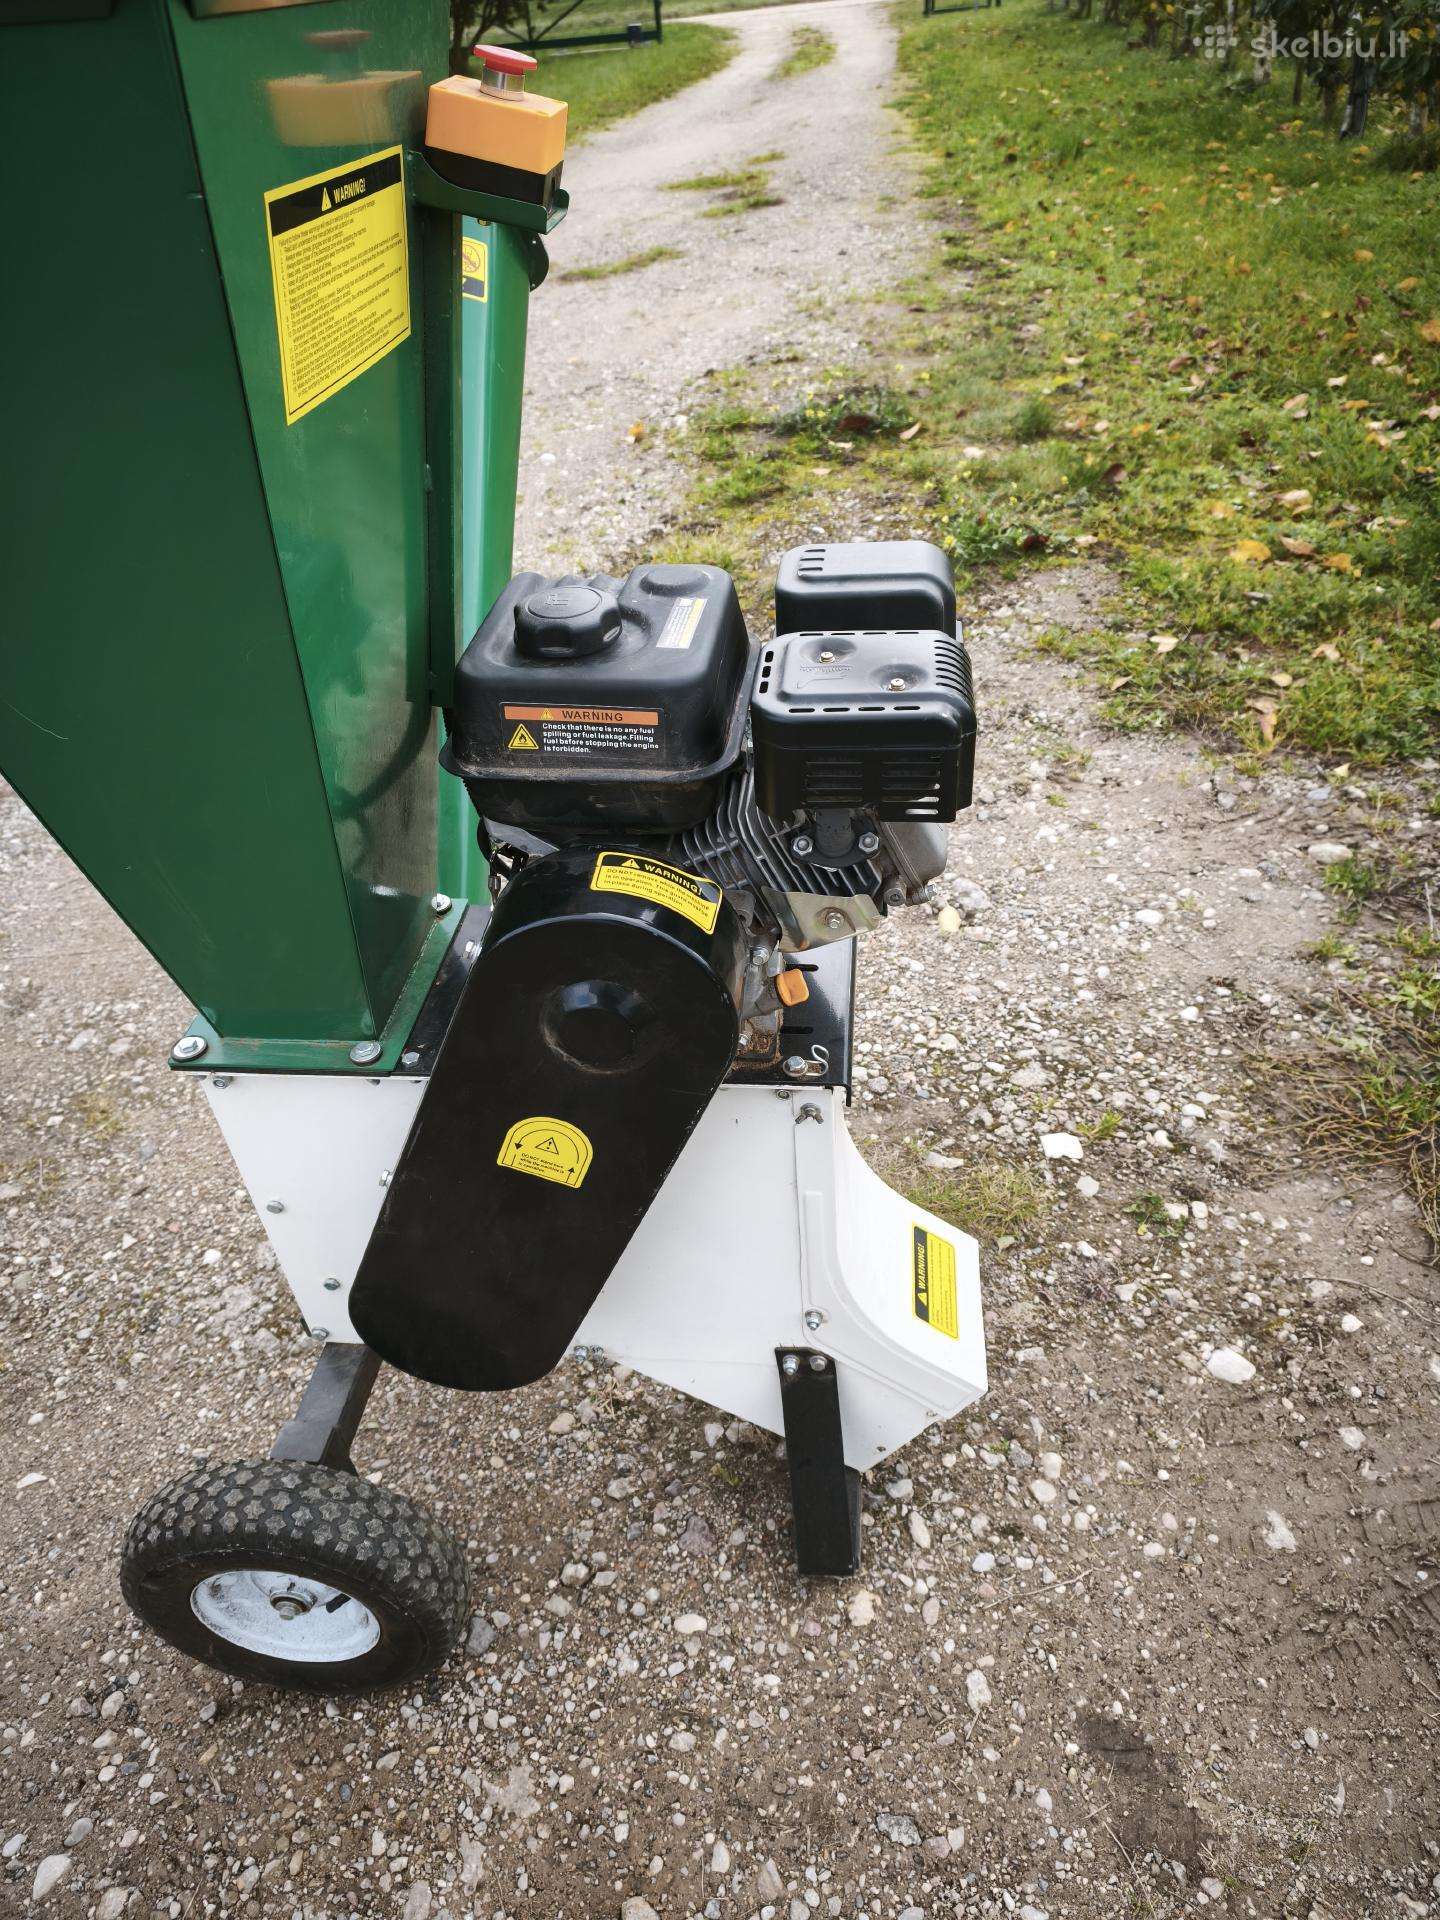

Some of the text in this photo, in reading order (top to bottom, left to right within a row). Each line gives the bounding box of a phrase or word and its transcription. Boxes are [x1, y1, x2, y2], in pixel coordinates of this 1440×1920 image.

[333, 178, 366, 204] WARNING!
[562, 710, 623, 721] WARNING
[583, 724, 603, 732] there
[585, 739, 618, 748] stopping
[645, 863, 703, 895] WARNING!
[918, 1243, 926, 1290] WARNING!
